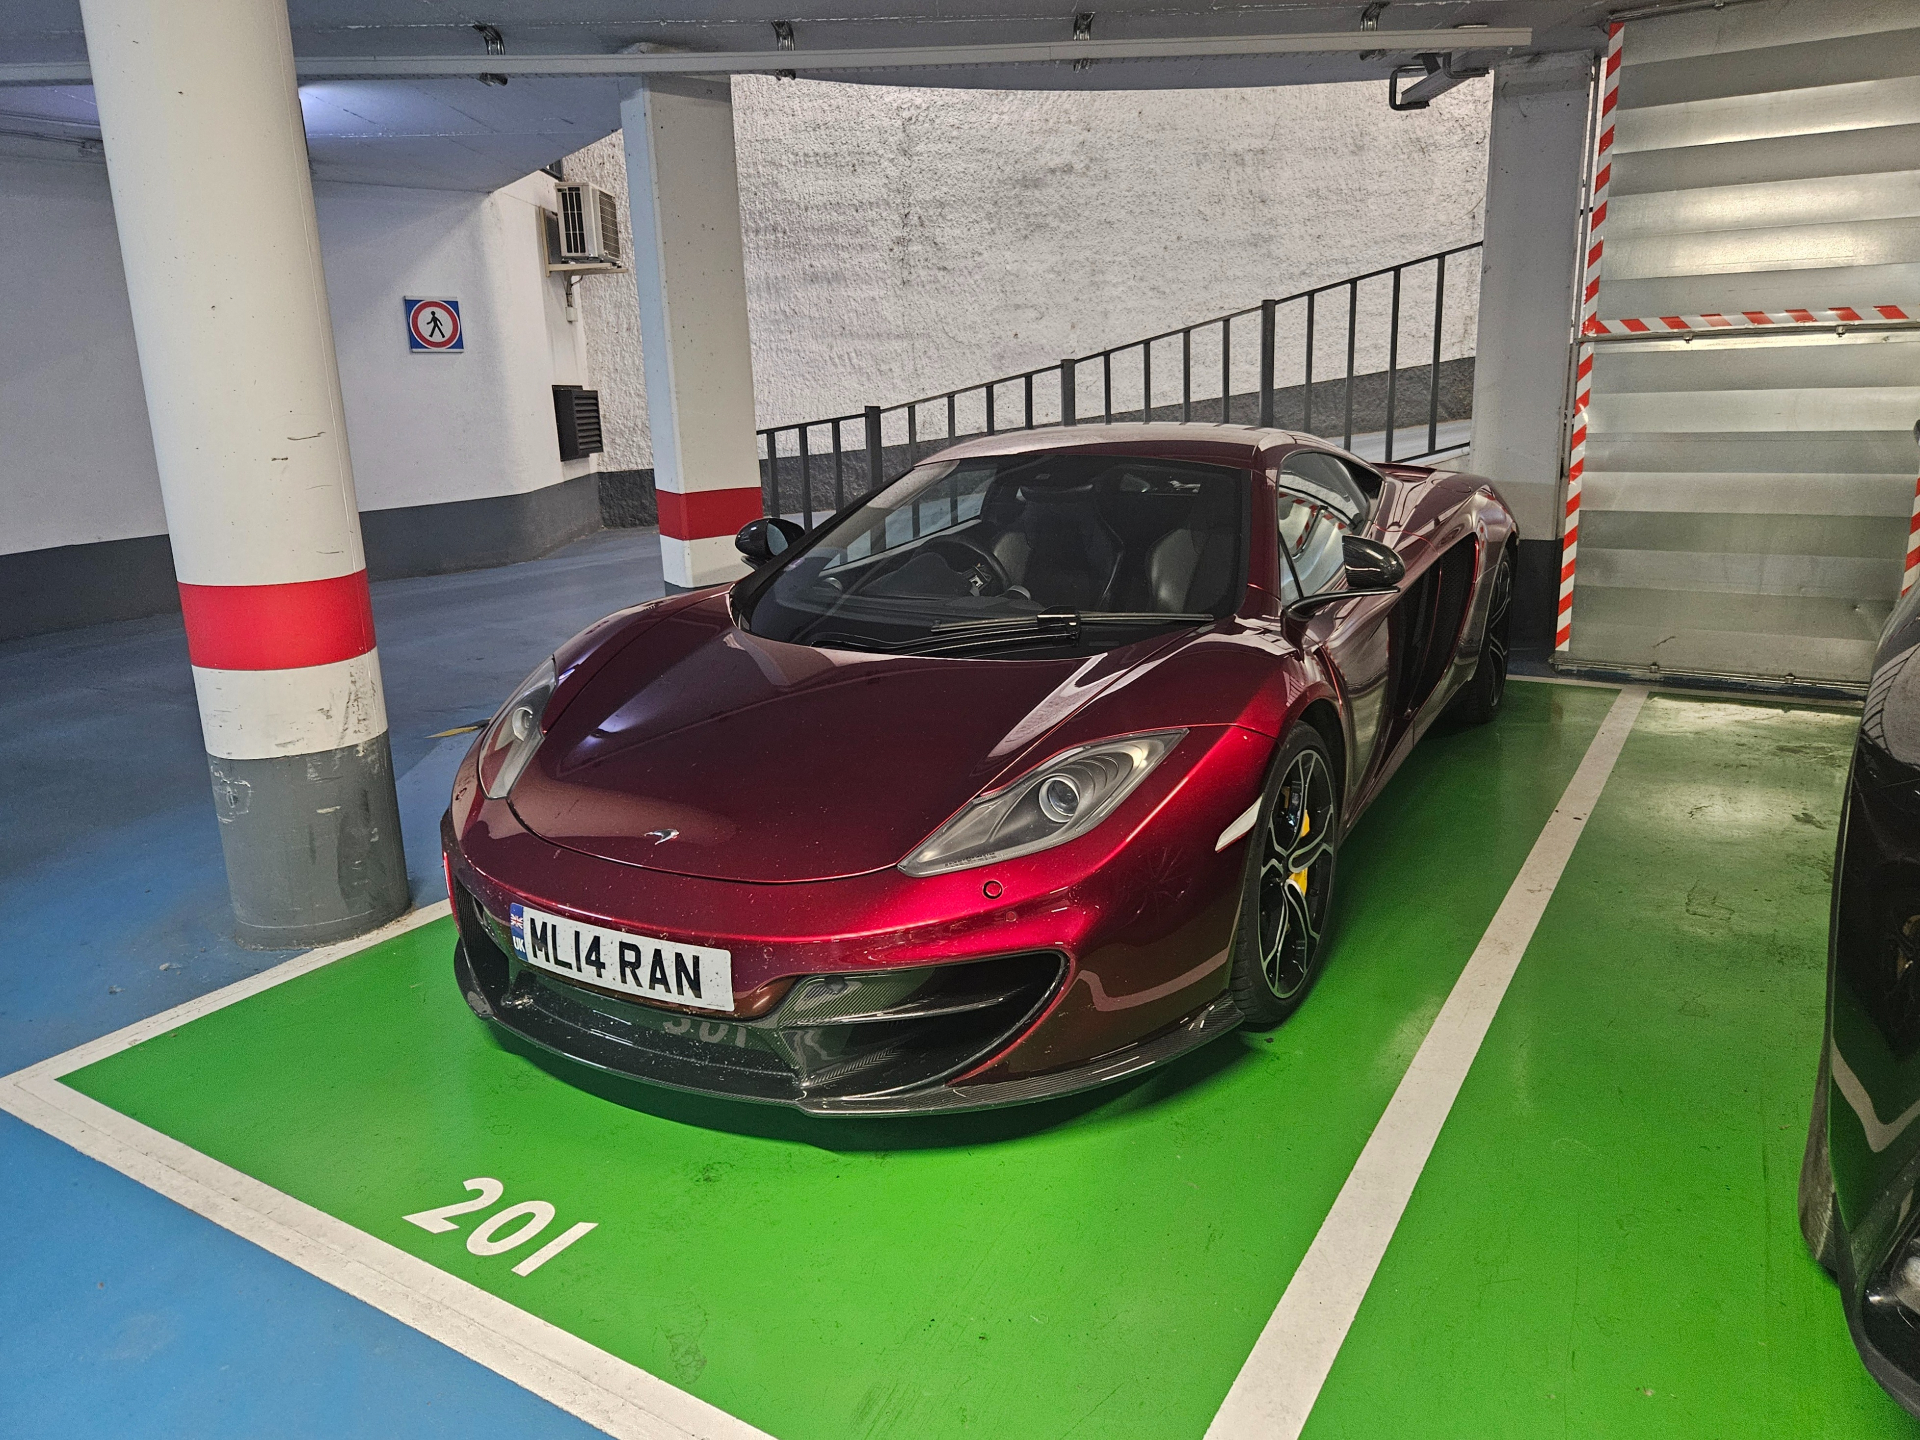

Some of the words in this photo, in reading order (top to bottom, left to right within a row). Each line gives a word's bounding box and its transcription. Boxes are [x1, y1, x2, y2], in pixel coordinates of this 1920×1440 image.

[512, 935, 526, 953] UK
[529, 916, 605, 979] ML14
[618, 940, 702, 999] RAN
[401, 1177, 600, 1277] 201
